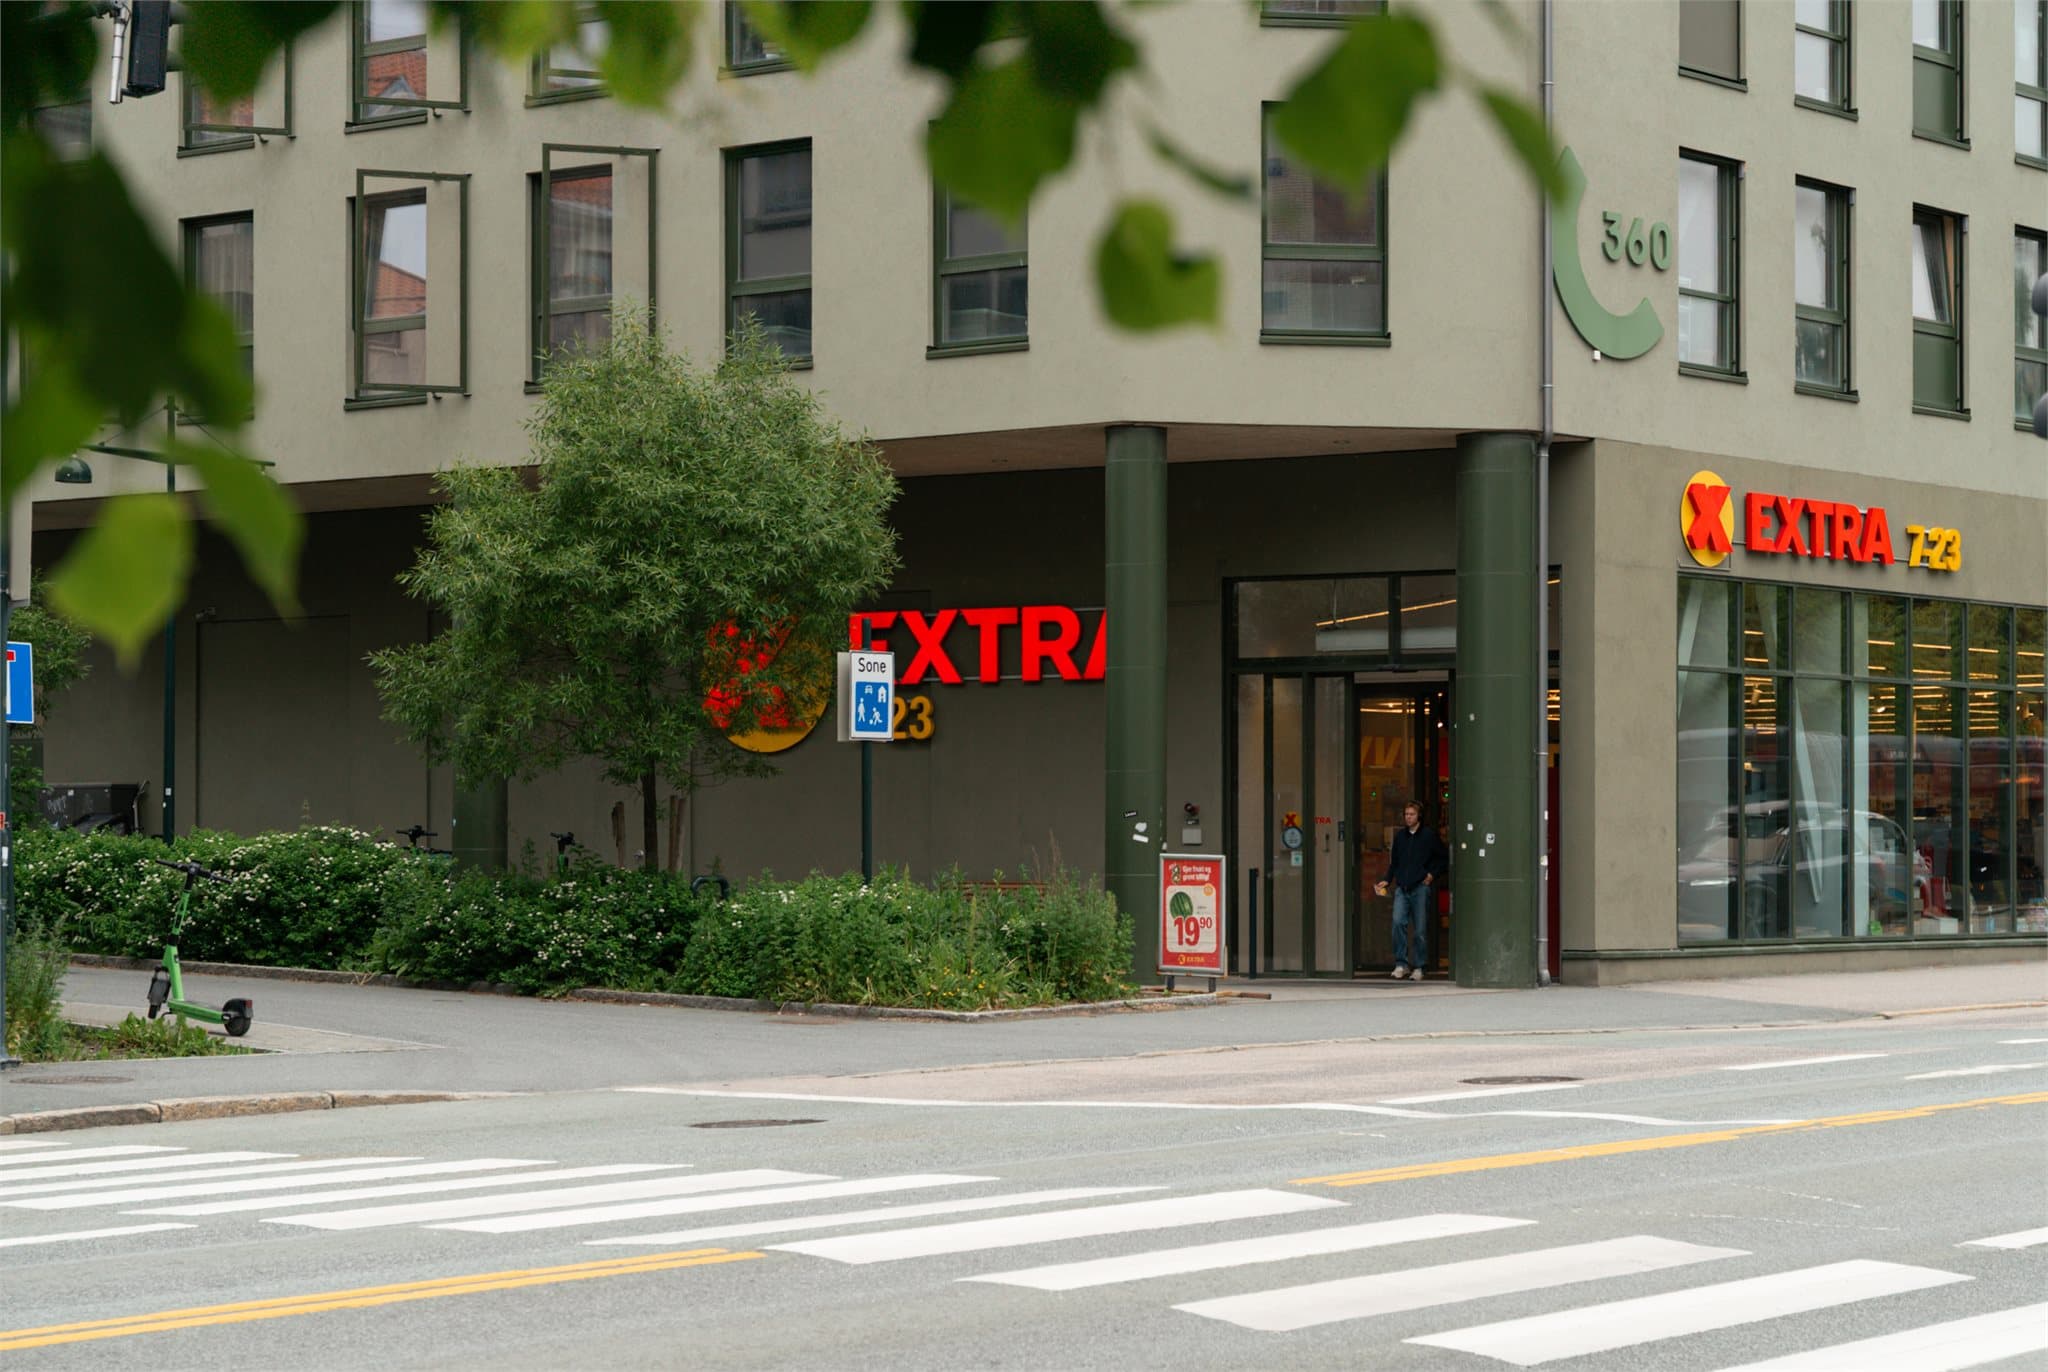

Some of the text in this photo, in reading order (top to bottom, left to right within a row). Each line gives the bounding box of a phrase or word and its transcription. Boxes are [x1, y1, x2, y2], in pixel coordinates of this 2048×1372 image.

[1601, 210, 1672, 272] 360
[1745, 492, 1895, 565] EXTRA
[1906, 525, 1961, 572] 7-23
[858, 657, 887, 673] Sone
[1174, 916, 1213, 946] 19 90
